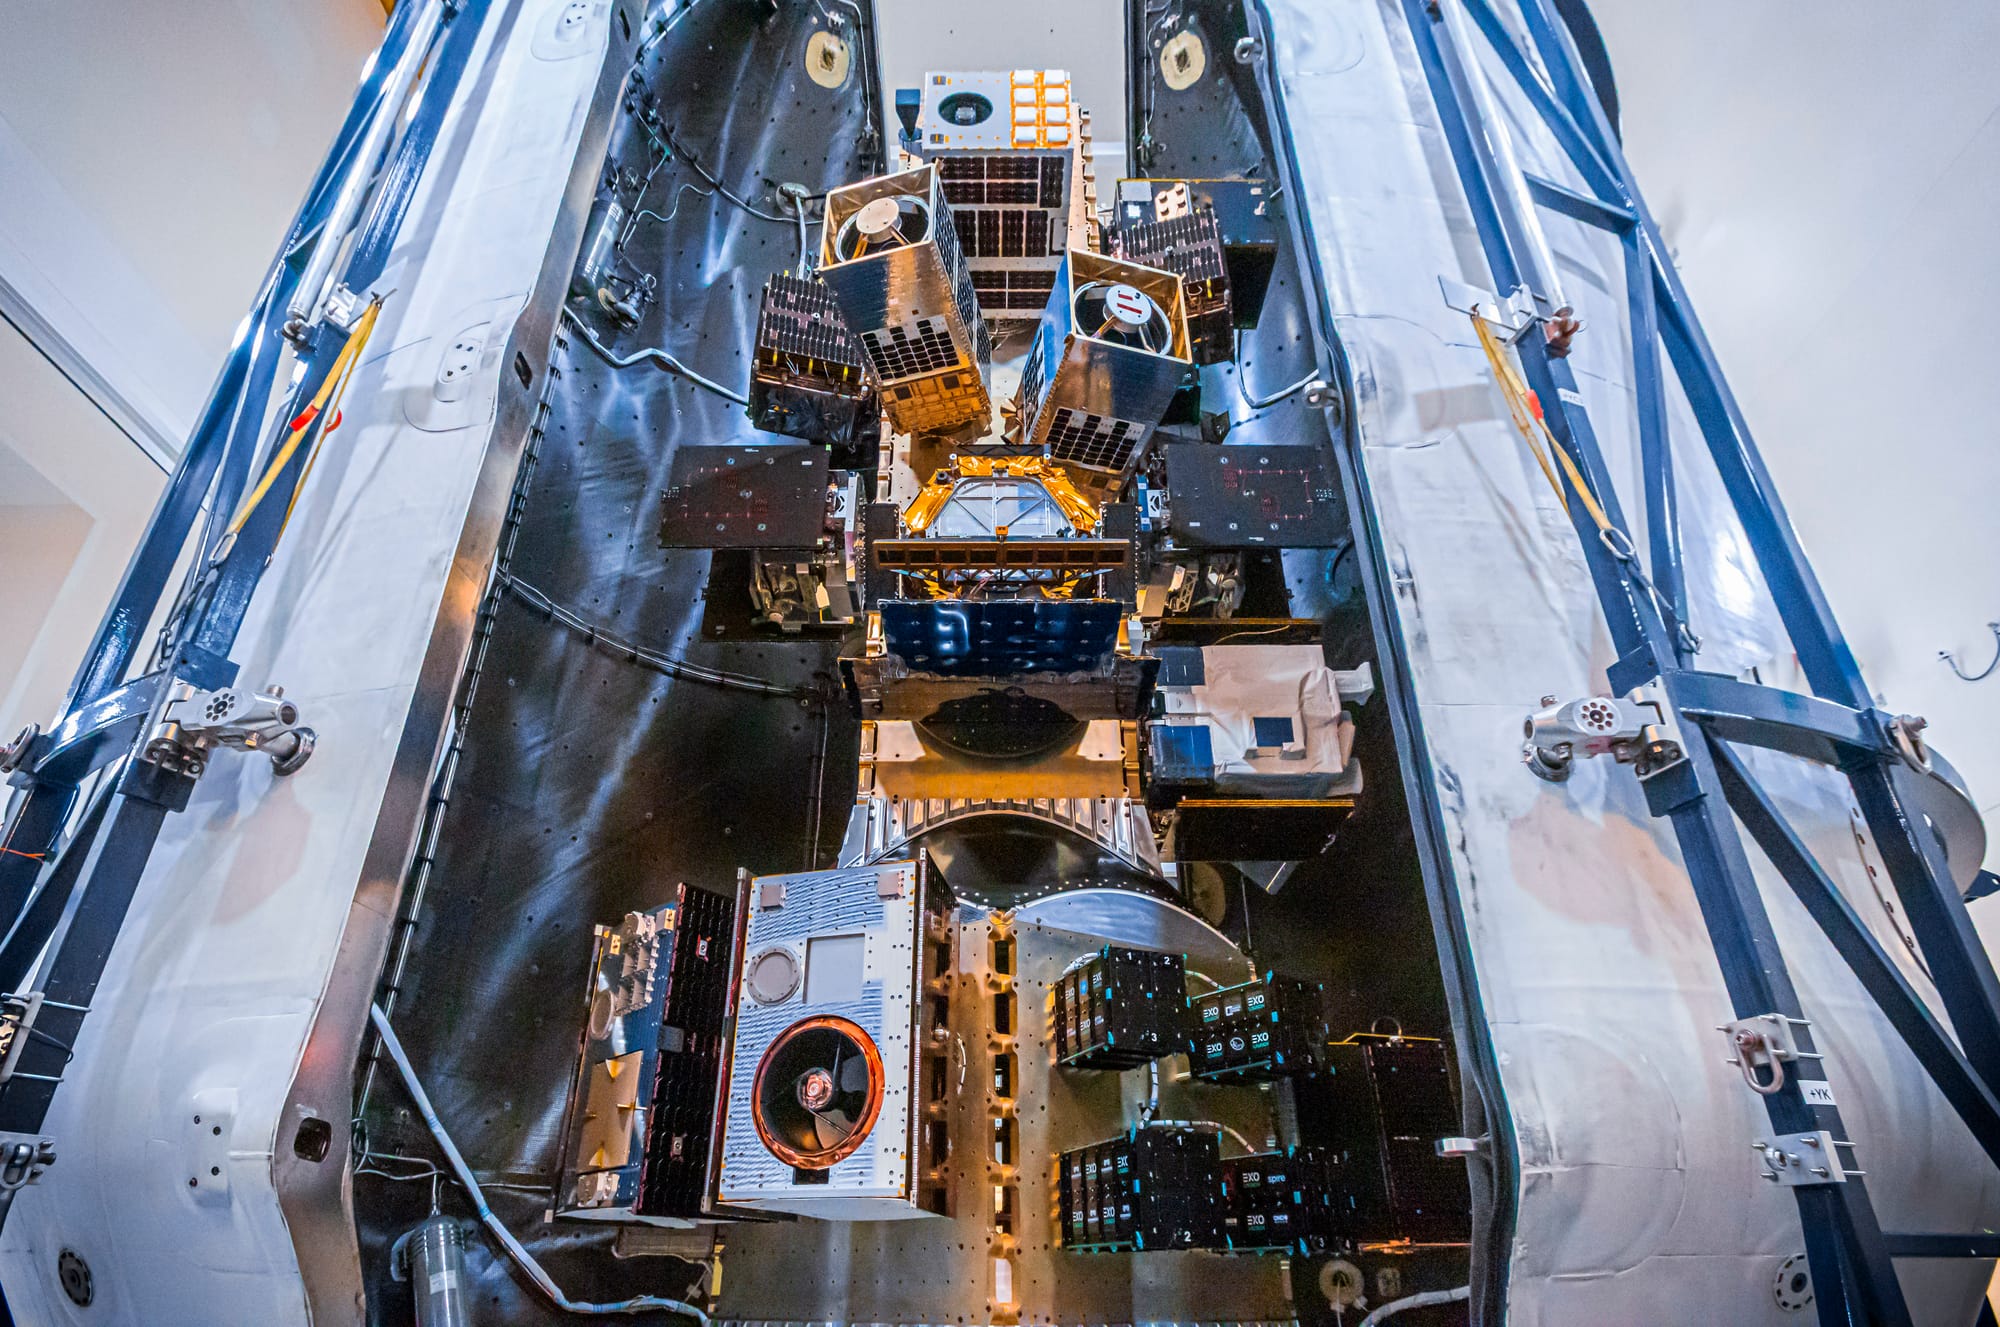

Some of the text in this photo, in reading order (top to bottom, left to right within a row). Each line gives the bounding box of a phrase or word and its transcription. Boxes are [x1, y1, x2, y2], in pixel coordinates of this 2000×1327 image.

[1126, 951, 1132, 960] 1
[1163, 956, 1170, 965] 2
[1248, 994, 1265, 1007] EXO
[1203, 1006, 1219, 1018] EXO
[1151, 1032, 1157, 1042] 3
[1251, 1032, 1269, 1044] EXO
[1206, 1042, 1223, 1054] EXO
[1809, 1088, 1832, 1101] +YK
[1176, 1135, 1183, 1146] 1
[1242, 1171, 1260, 1183] EXO
[1103, 1206, 1115, 1218] EXO
[1247, 1215, 1265, 1226] EXO
[1184, 1230, 1191, 1242] 2
